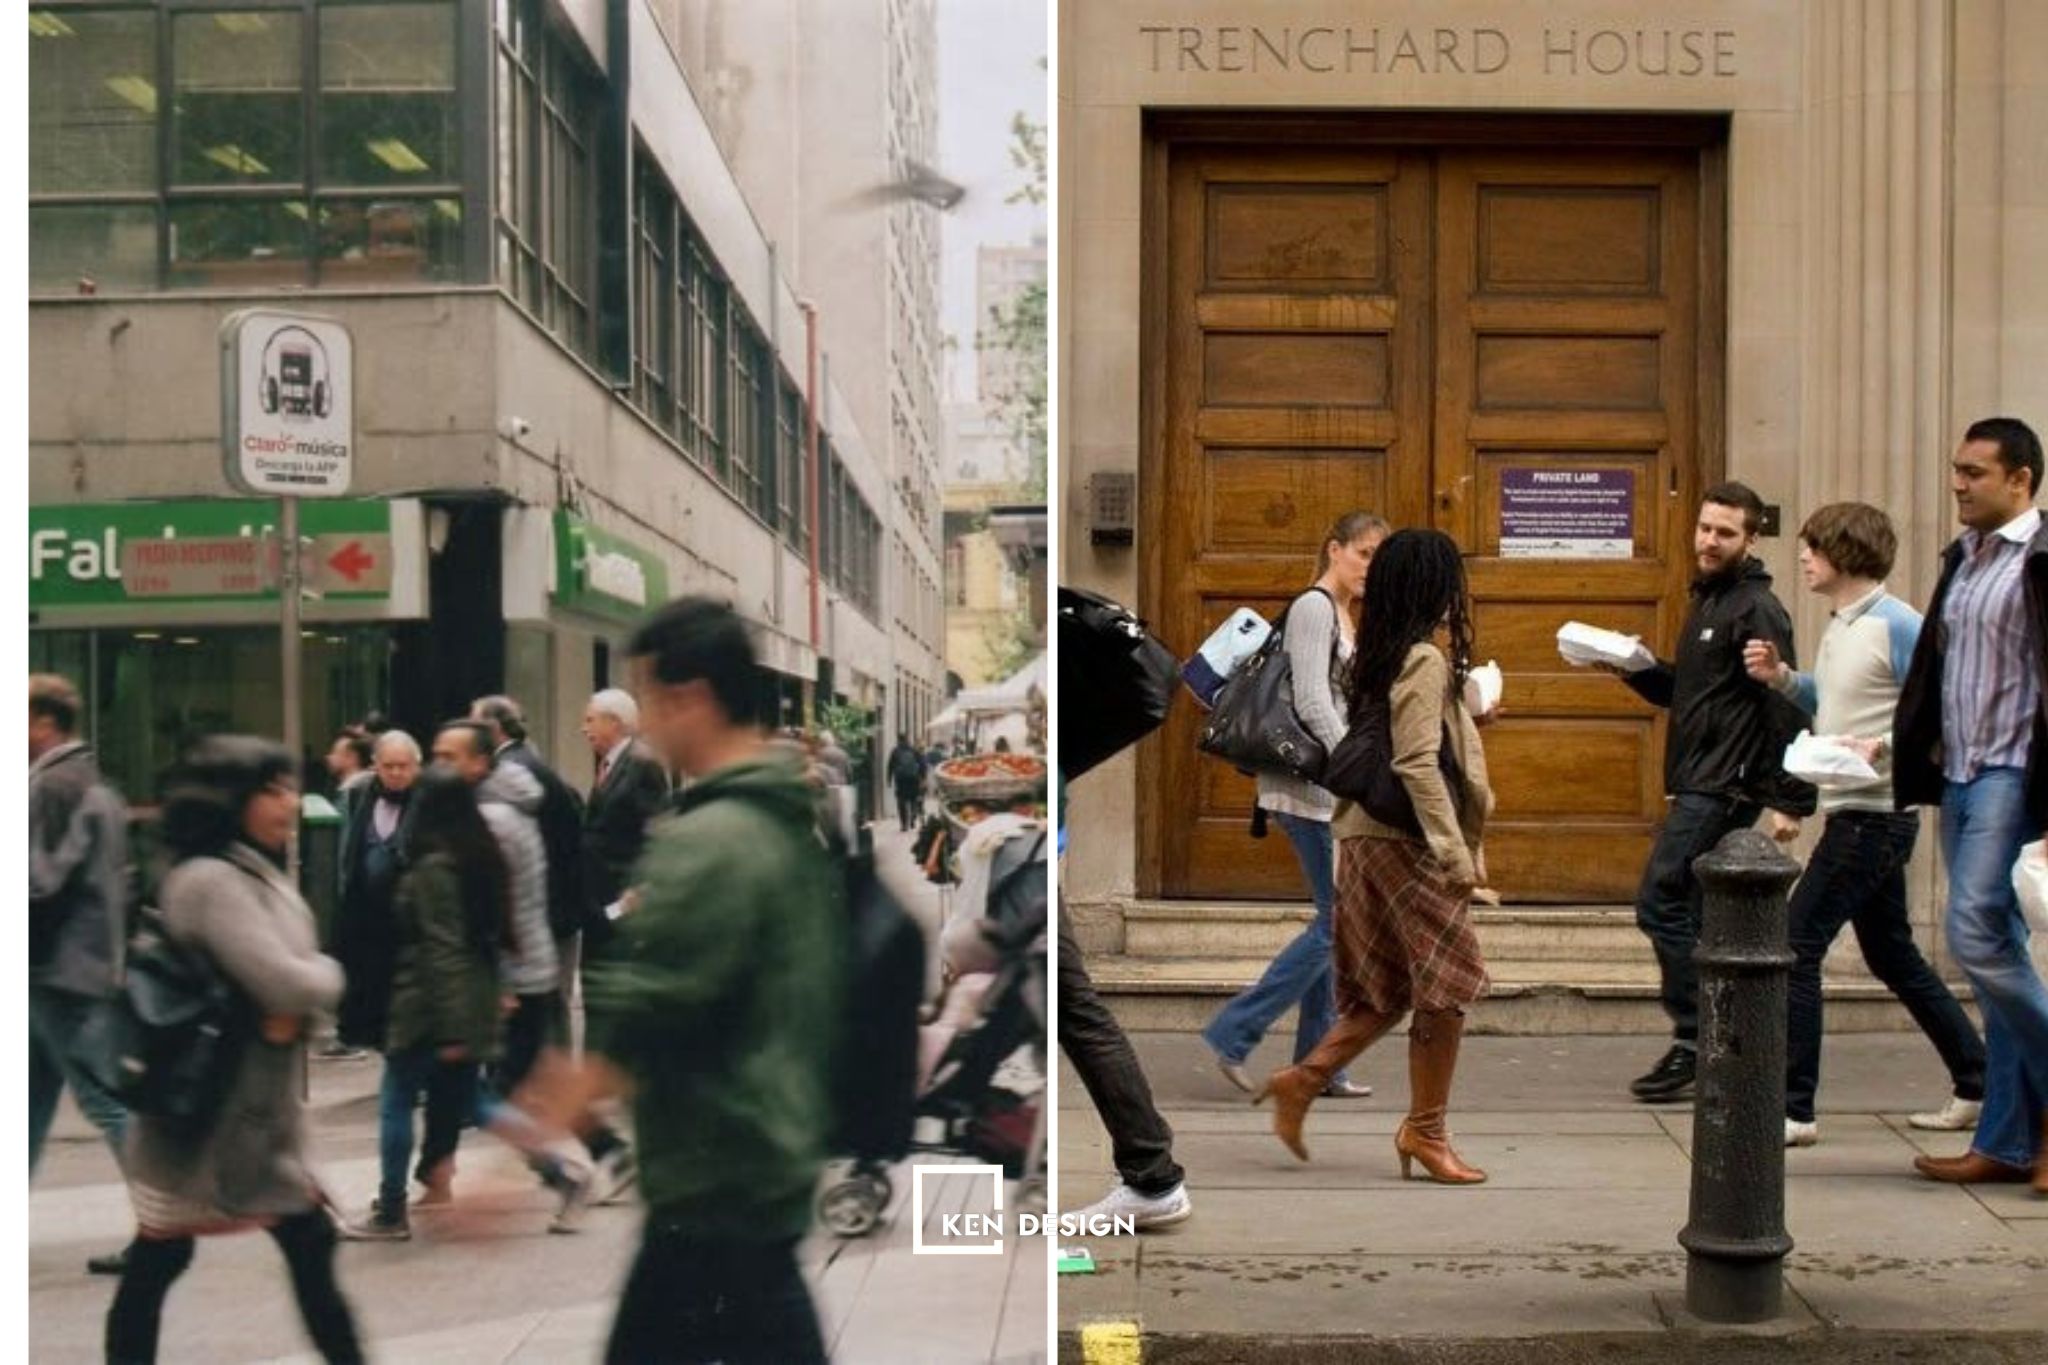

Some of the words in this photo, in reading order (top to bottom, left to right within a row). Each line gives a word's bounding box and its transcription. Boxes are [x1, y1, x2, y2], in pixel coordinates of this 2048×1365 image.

[1139, 27, 1510, 73] TRENCHARD
[1543, 30, 1738, 76] HOUSE
[1533, 472, 1572, 483] PRIVATE
[1574, 473, 1600, 483] LAND
